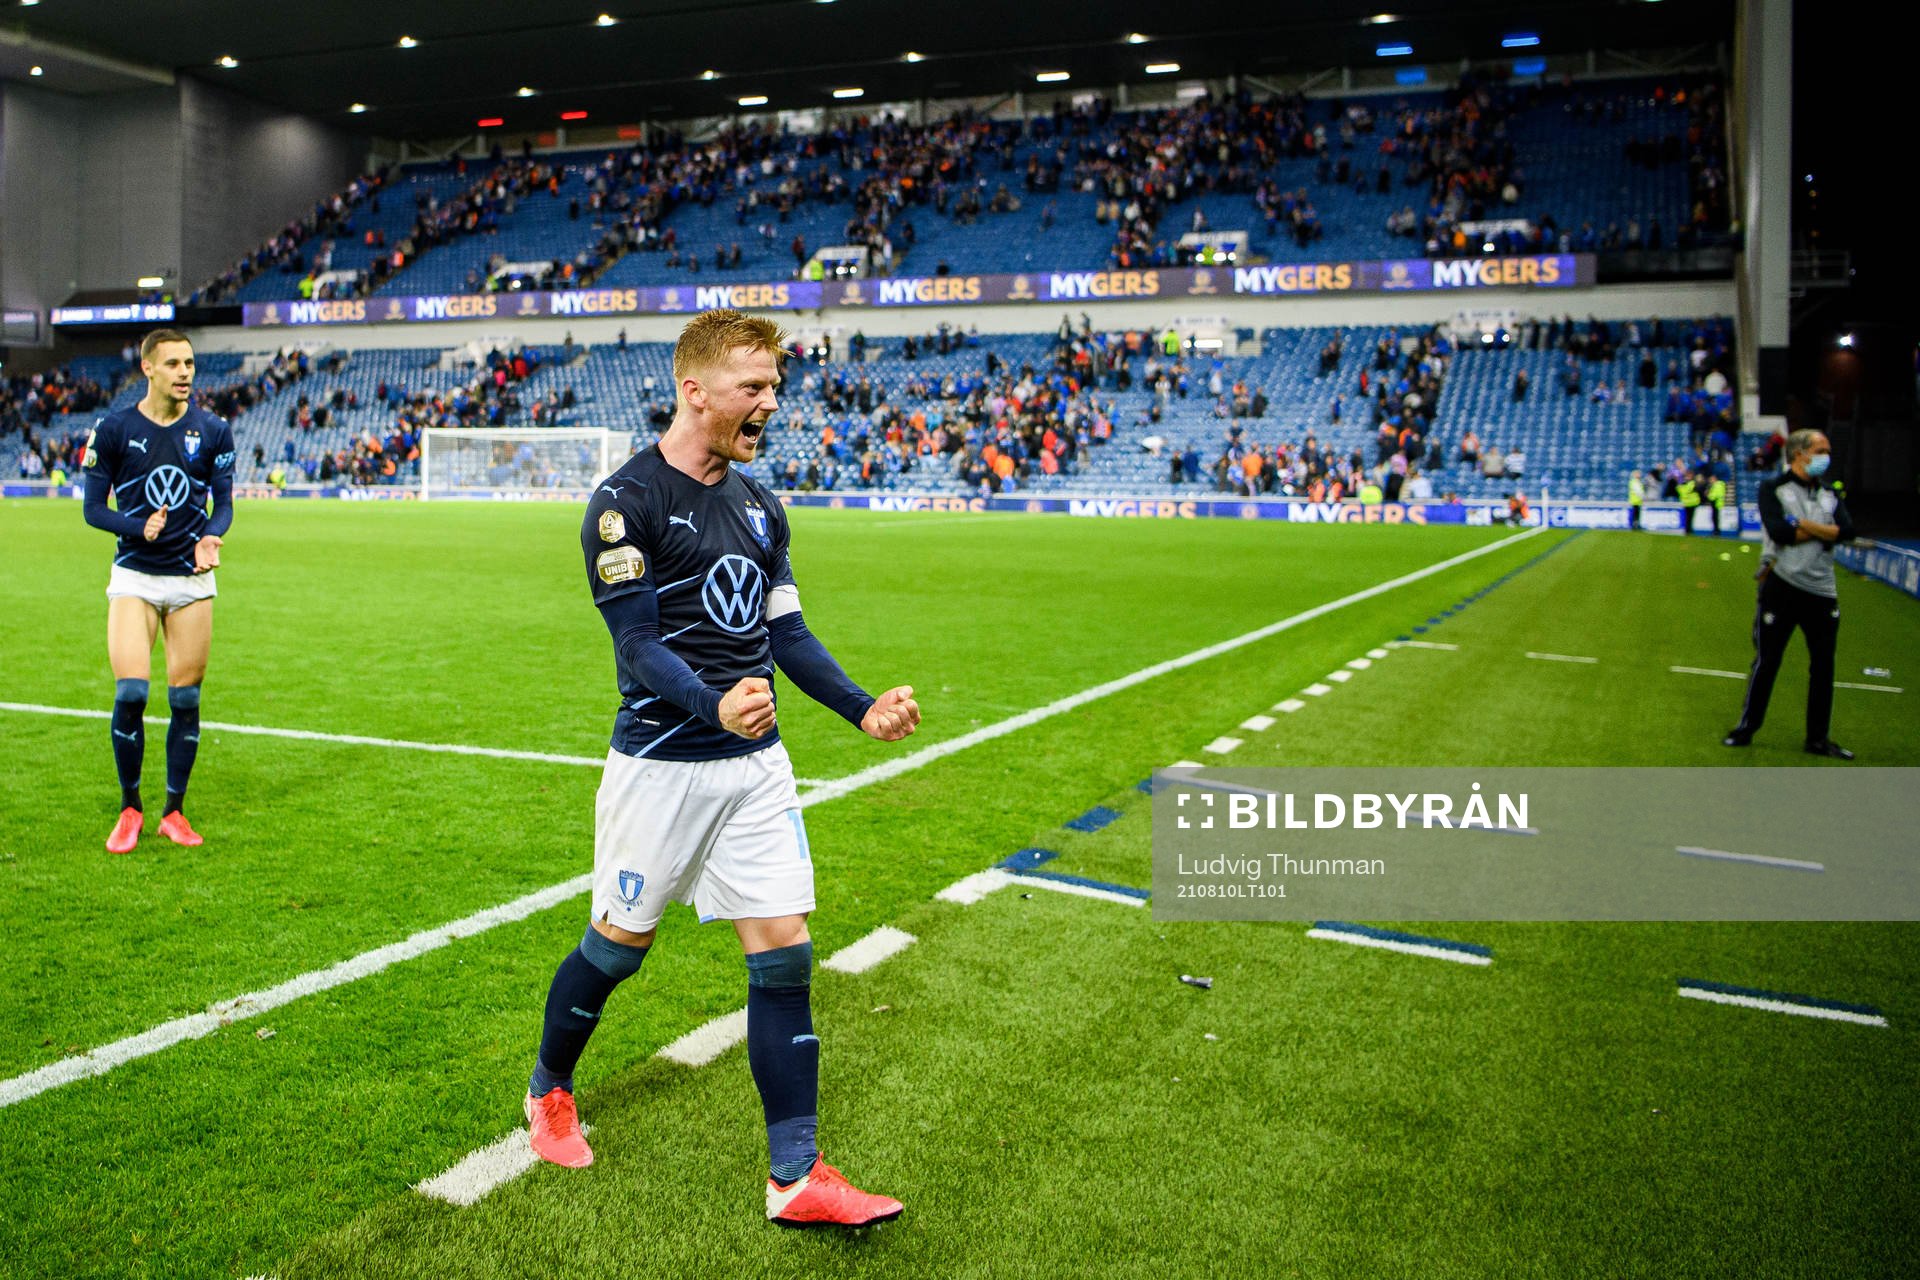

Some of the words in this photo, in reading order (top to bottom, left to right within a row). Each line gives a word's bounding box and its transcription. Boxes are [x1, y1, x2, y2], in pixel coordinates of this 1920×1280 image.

[1050, 270, 1160, 298] MYGERS
[1234, 264, 1352, 293] MYGERS
[1433, 258, 1560, 287] MYGERS
[551, 290, 637, 314] MYGERS
[696, 284, 789, 309] MYGERS
[879, 277, 981, 303] MYGERS
[290, 301, 366, 323] MYGERS
[416, 296, 497, 319] MYGERS
